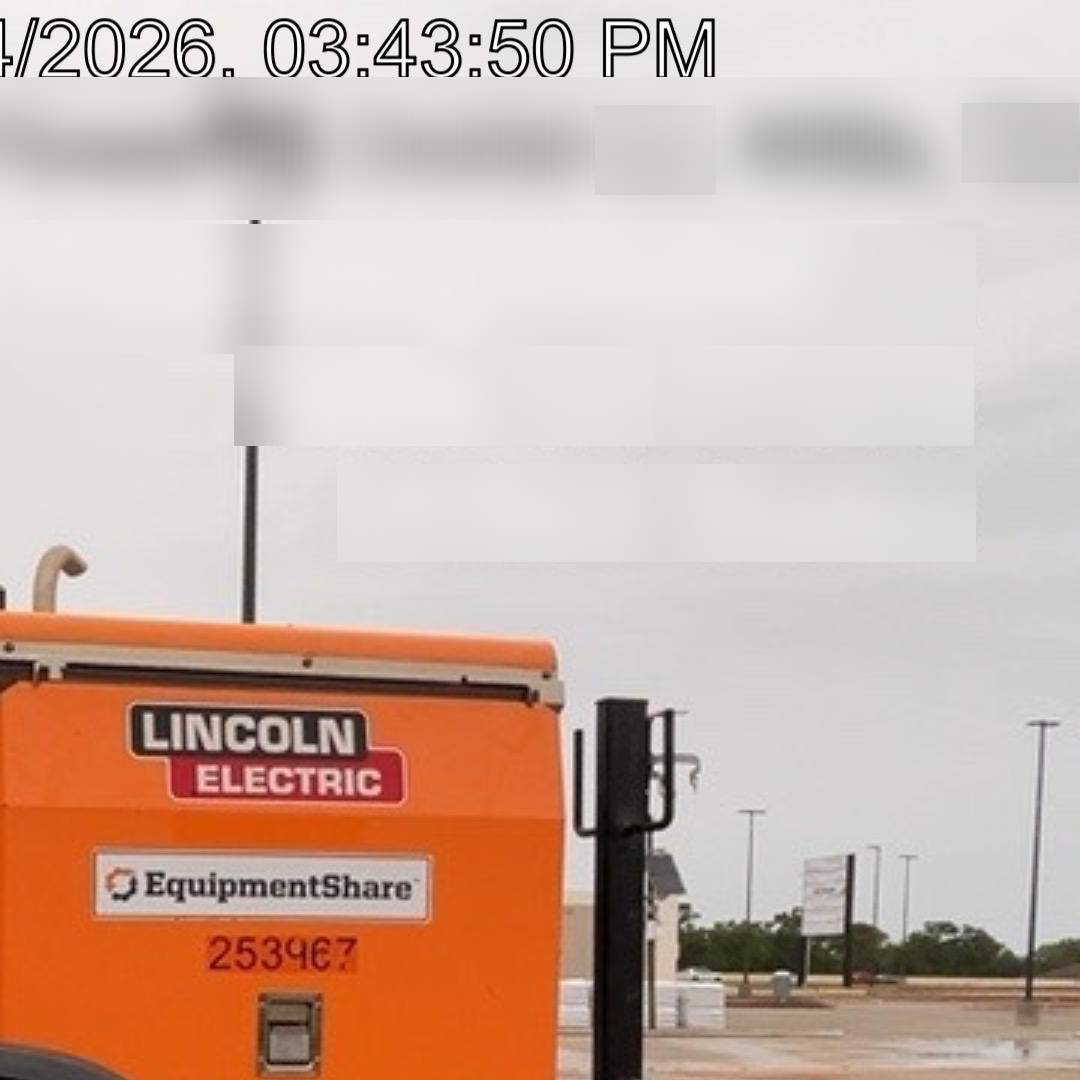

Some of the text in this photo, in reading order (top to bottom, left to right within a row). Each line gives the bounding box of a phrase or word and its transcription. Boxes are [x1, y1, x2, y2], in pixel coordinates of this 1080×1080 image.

[141, 712, 356, 757] LINCOLN
[196, 764, 383, 796] ELECTRIC
[145, 871, 413, 904] EquipmentShare
